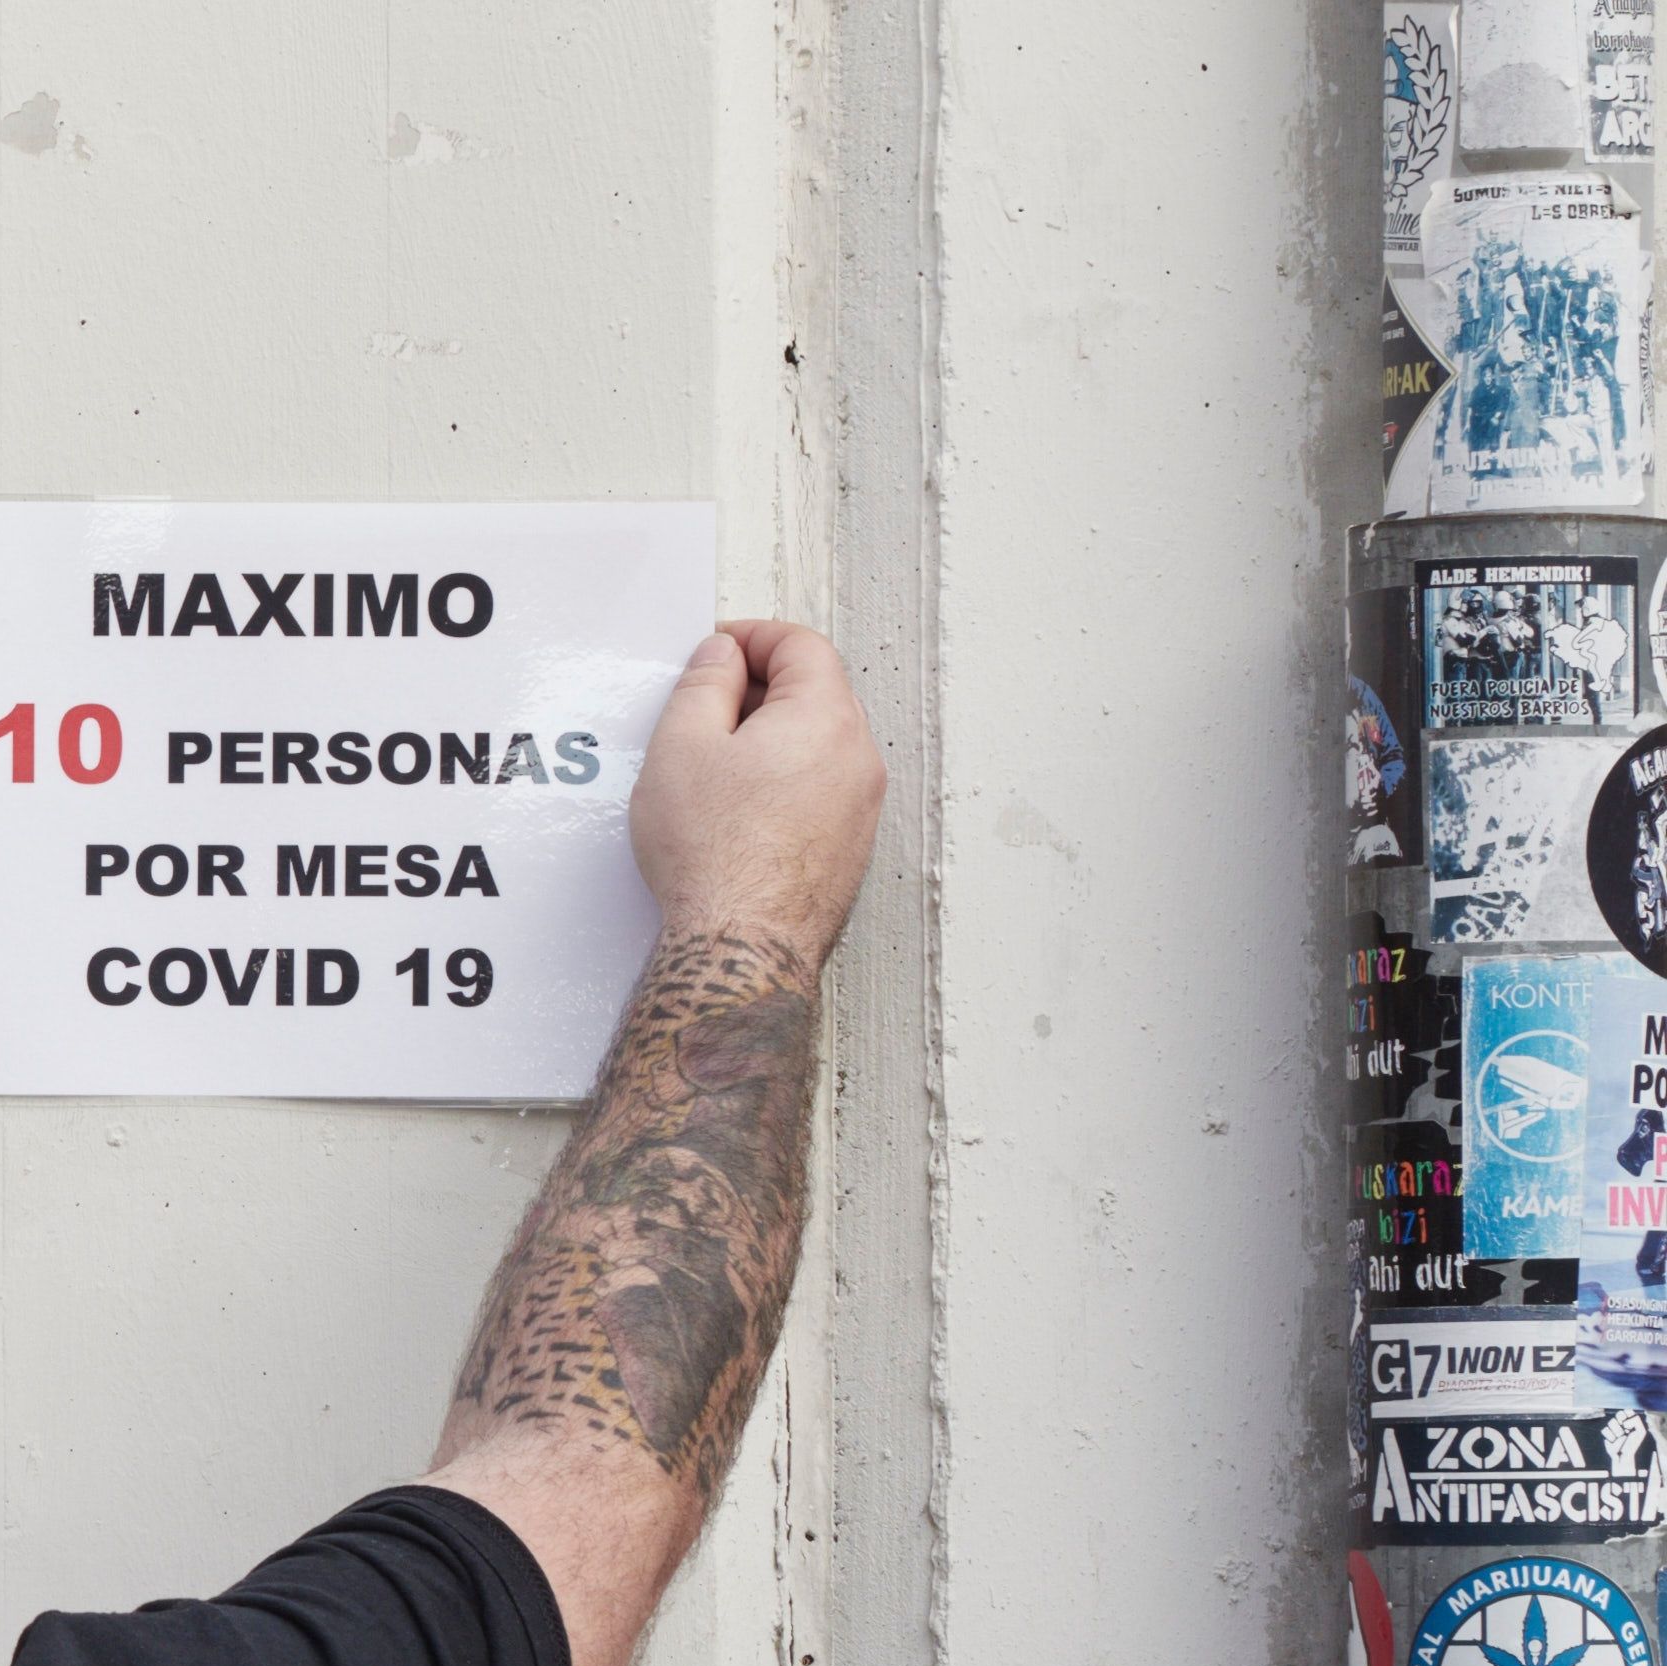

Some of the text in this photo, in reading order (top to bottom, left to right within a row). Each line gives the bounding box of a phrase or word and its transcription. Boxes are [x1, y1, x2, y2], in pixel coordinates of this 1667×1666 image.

[1429, 565, 1592, 586] ALDE HEMENDIK!
[93, 573, 495, 638] MAXIMO
[1430, 676, 1579, 699] FUERA POLICÍA DE
[1430, 699, 1591, 719] NUESTROS BARRIOS
[169, 731, 600, 785] PERSONAS
[86, 843, 501, 897] POR MESA
[86, 948, 494, 1007] COVID 19
[1368, 1038, 1406, 1078] dut
[1379, 1207, 1428, 1245] bizi
[1369, 1252, 1470, 1293] ahi dut
[1532, 1345, 1576, 1373] EZ
[1426, 1426, 1586, 1469] ZONA
[1447, 1564, 1612, 1617] MARIJUANA
